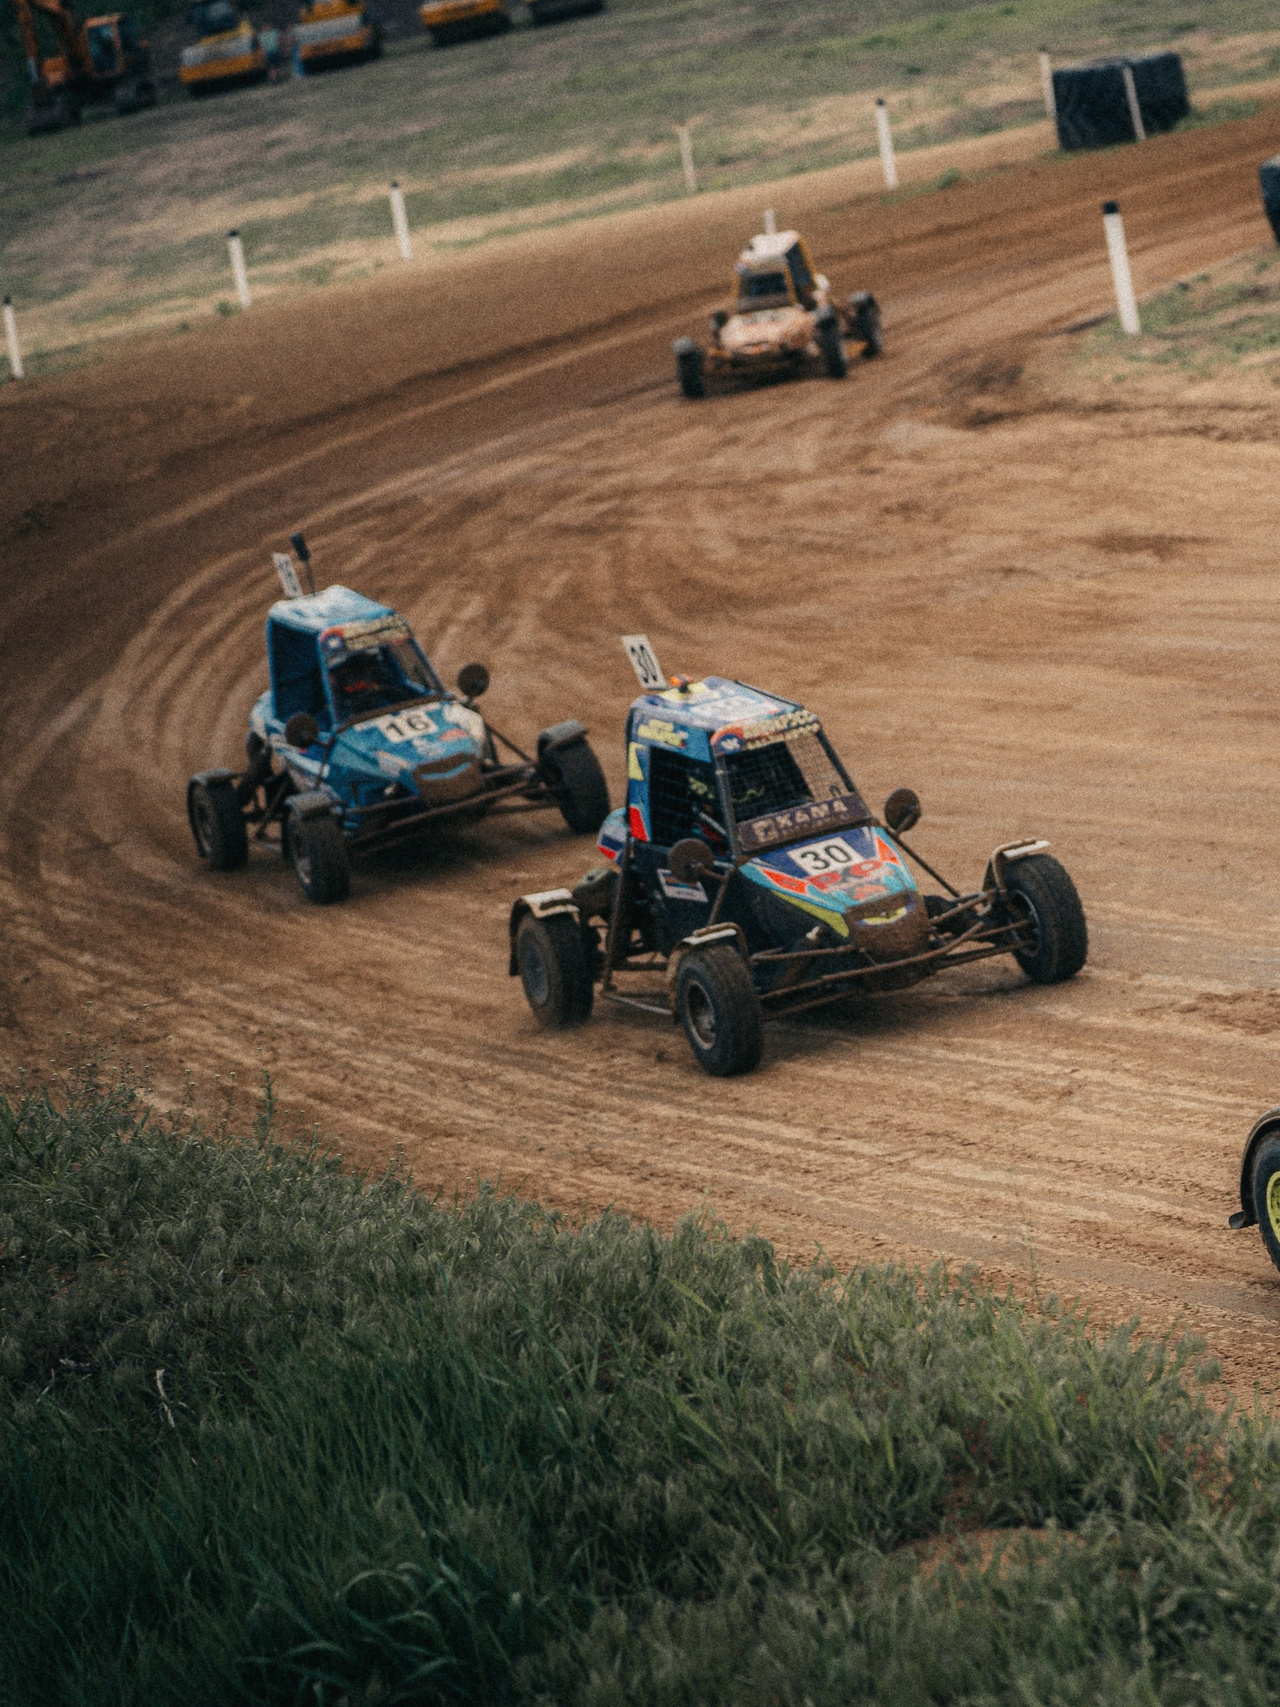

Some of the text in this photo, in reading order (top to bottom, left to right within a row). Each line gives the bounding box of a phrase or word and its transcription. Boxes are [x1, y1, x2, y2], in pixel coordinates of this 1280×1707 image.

[630, 644, 658, 684] 30
[386, 714, 430, 737] 16
[801, 845, 852, 870] 30
